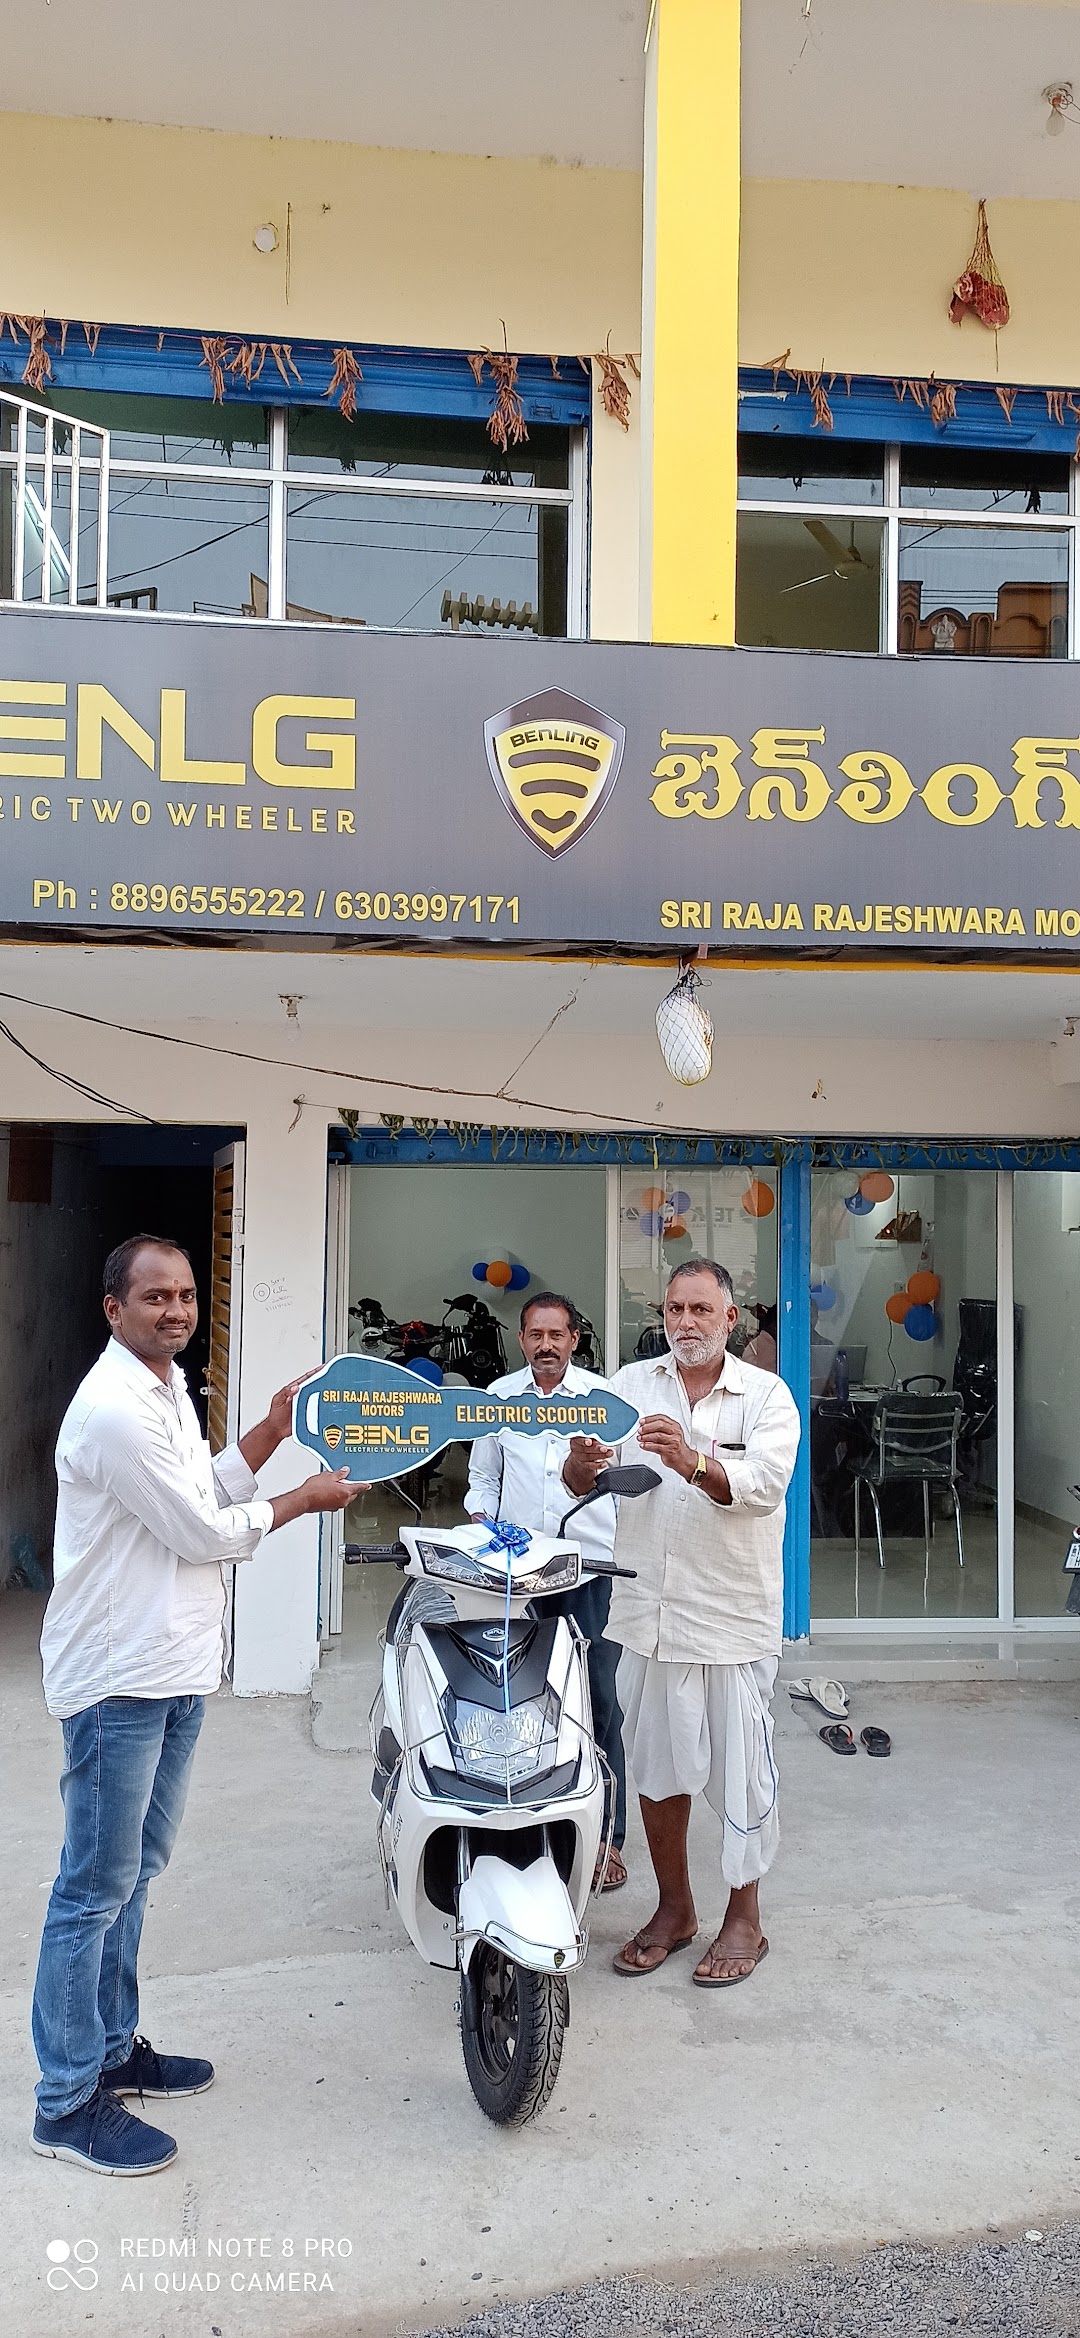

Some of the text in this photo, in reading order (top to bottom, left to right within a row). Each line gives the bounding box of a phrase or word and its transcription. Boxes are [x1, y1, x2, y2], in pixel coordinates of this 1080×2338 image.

[509, 728, 600, 751] BENLING
[67, 797, 151, 826] TWO
[166, 802, 357, 834] WHEELER
[32, 879, 77, 909] Ph
[109, 882, 305, 918] 8896555222
[334, 890, 520, 924] 6303997171
[660, 899, 712, 930] SRI
[722, 901, 804, 931] RAJA
[813, 903, 1026, 936] RAJESHWARA
[322, 1390, 443, 1405] SRI RAJA RAJESHWARA
[361, 1404, 405, 1417] MOTORS
[456, 1405, 608, 1425] ELECTRIC SCOOTER
[344, 1424, 430, 1446] BENLG
[396, 1446, 430, 1454] WHEELER
